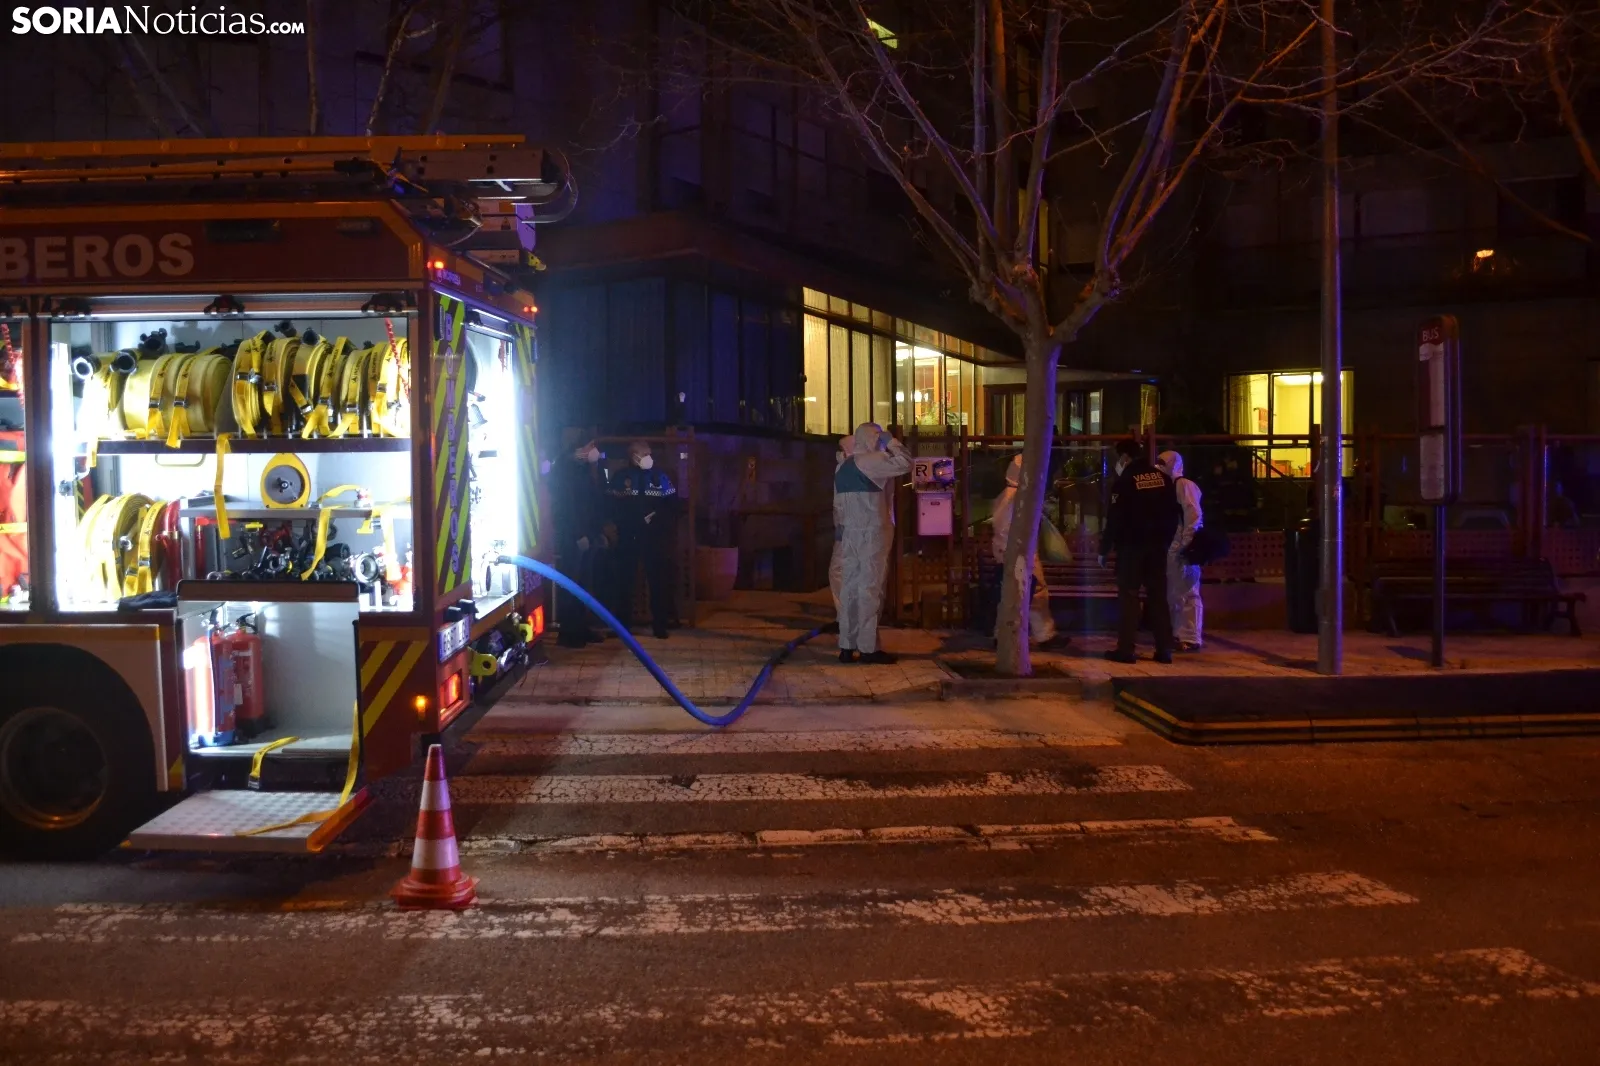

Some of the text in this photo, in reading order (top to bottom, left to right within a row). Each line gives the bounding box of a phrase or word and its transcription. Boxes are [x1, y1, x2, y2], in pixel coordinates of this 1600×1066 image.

[0, 233, 194, 278] BEROS
[1422, 326, 1440, 341] BUS
[445, 313, 460, 575] BOMBEROS
